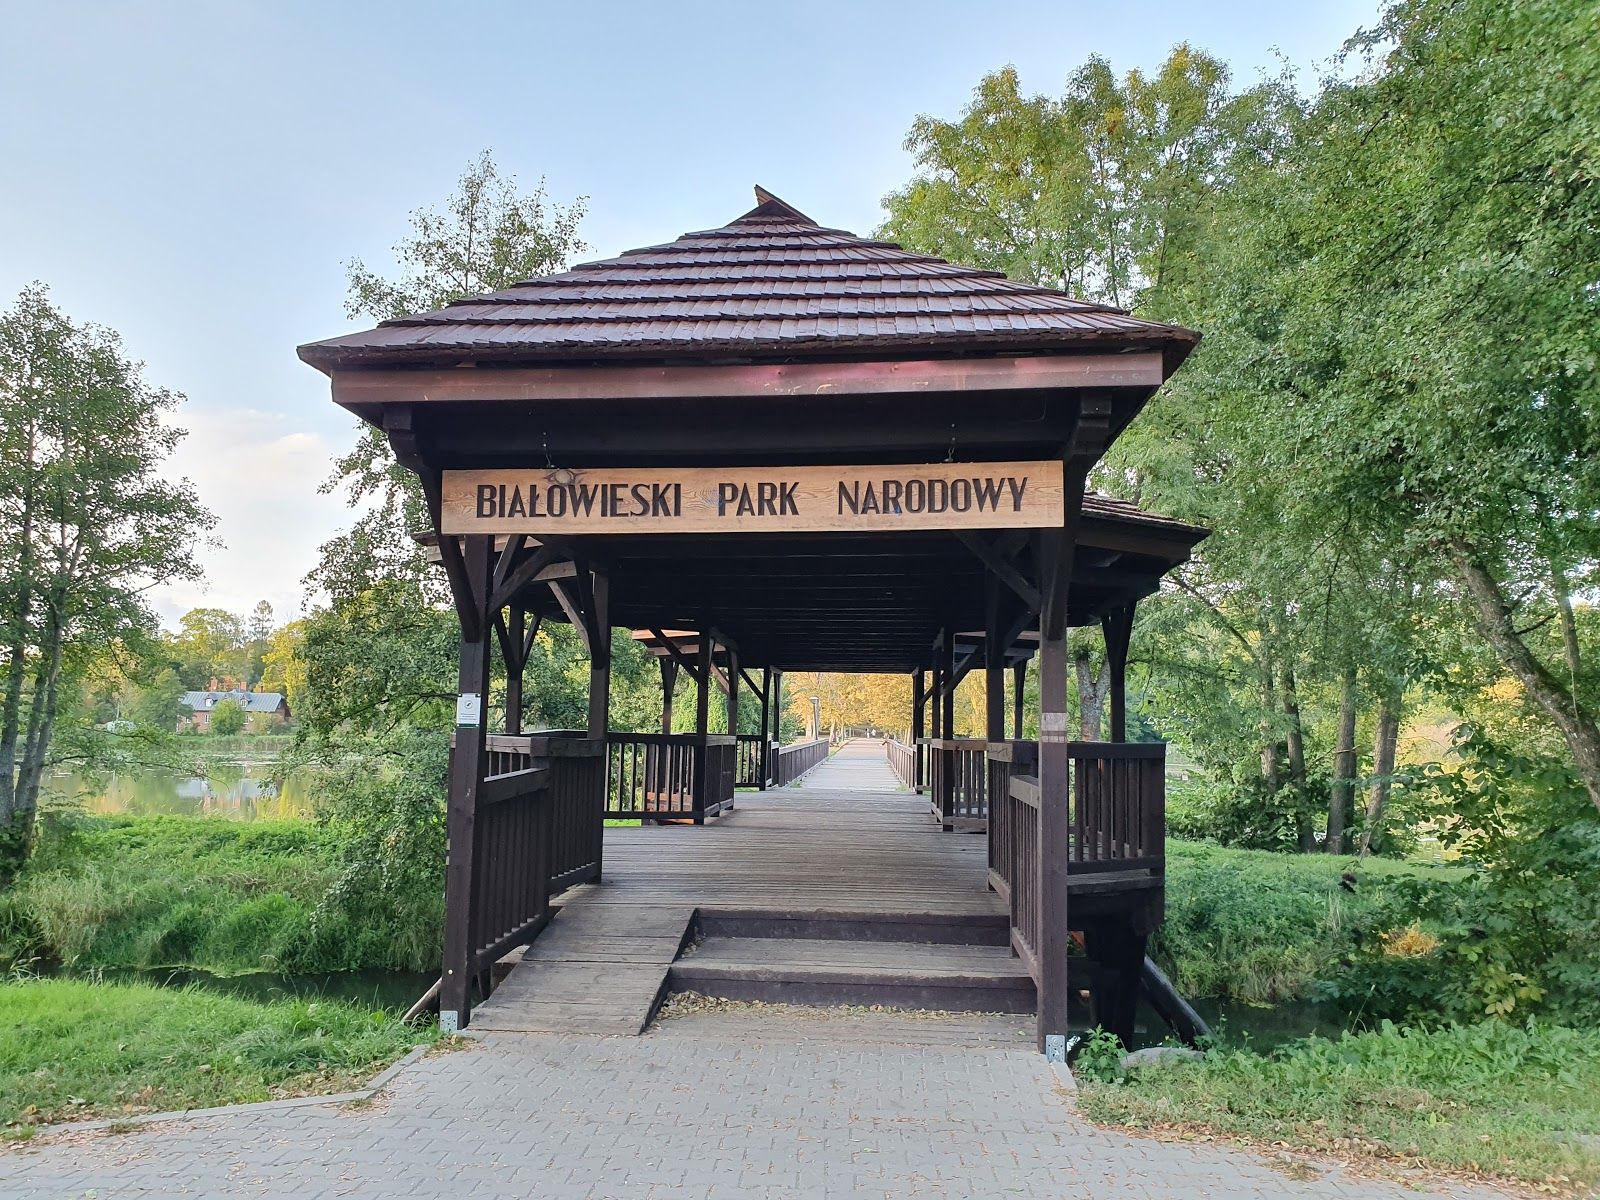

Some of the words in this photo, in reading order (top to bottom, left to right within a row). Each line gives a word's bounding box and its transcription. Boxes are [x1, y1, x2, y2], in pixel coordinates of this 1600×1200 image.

[476, 483, 681, 519] BIAŁOWIESKI
[718, 481, 799, 517] PARK
[838, 477, 1028, 515] NARODOWY
